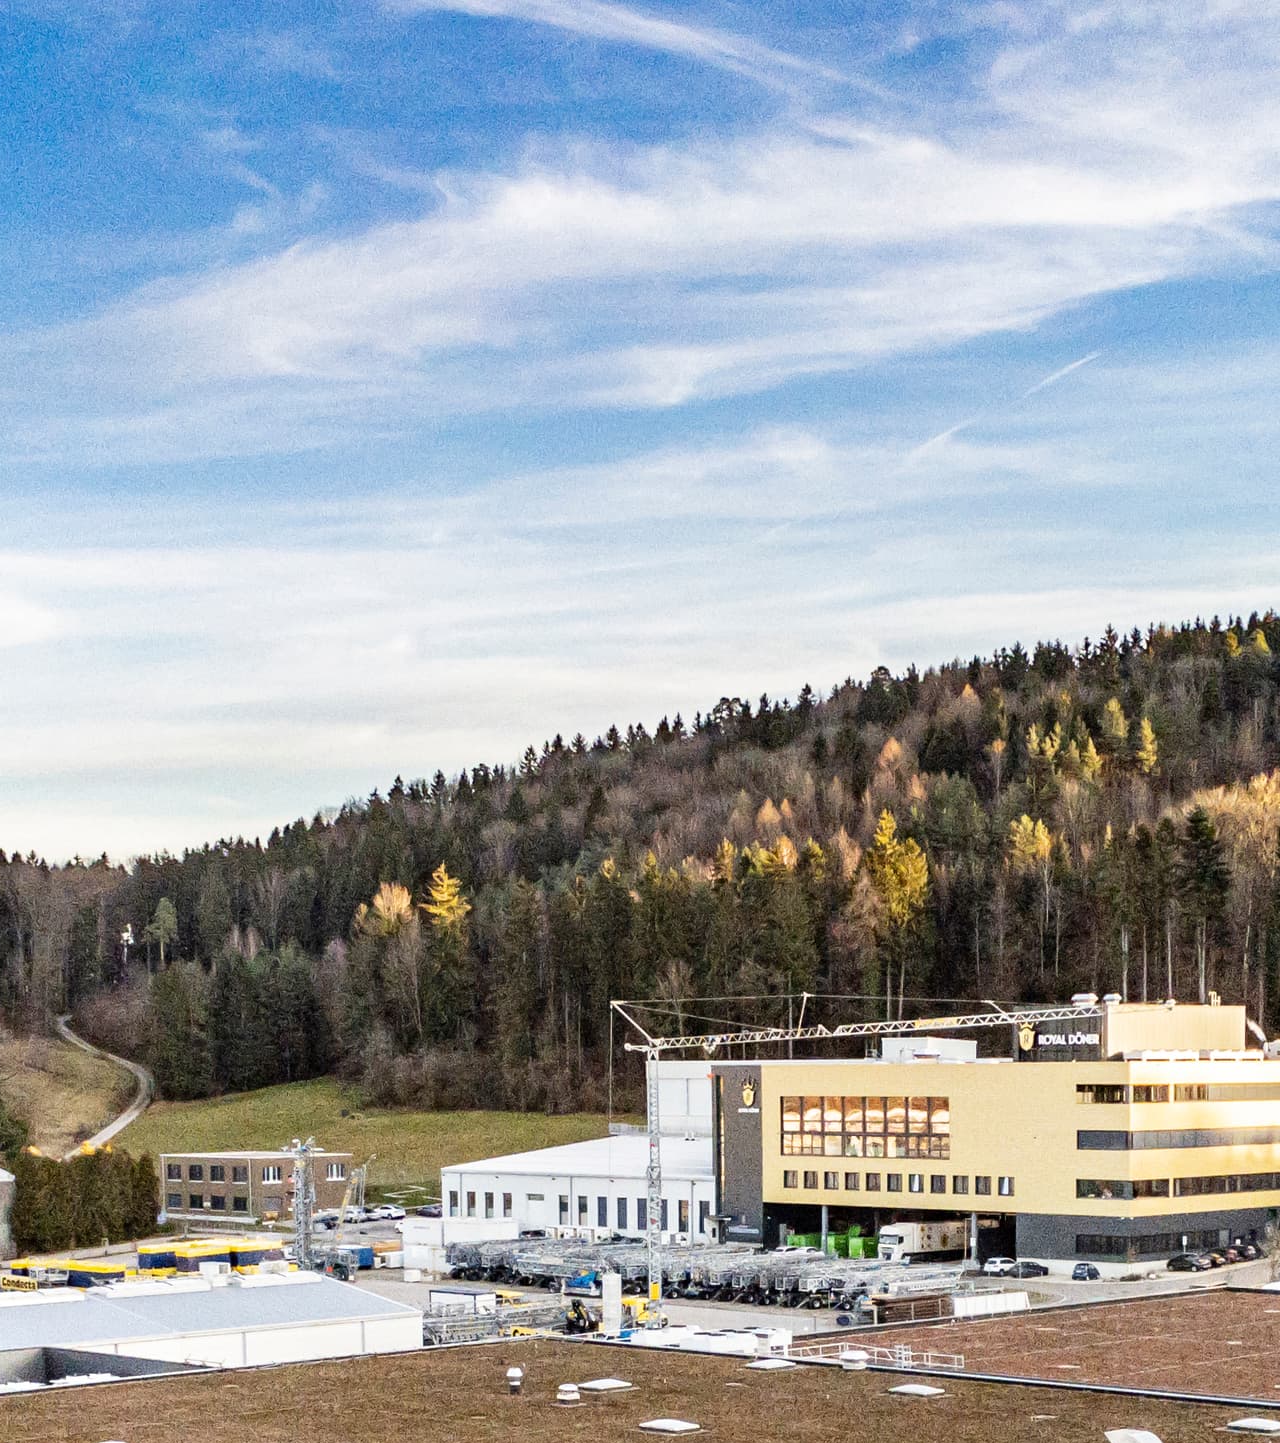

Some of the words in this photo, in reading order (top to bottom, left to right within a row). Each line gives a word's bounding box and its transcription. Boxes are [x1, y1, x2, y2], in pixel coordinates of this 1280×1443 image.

[1038, 1034, 1067, 1045] ROYAL
[1068, 1031, 1099, 1045] DÖNER
[2, 1277, 36, 1289] Condecta
